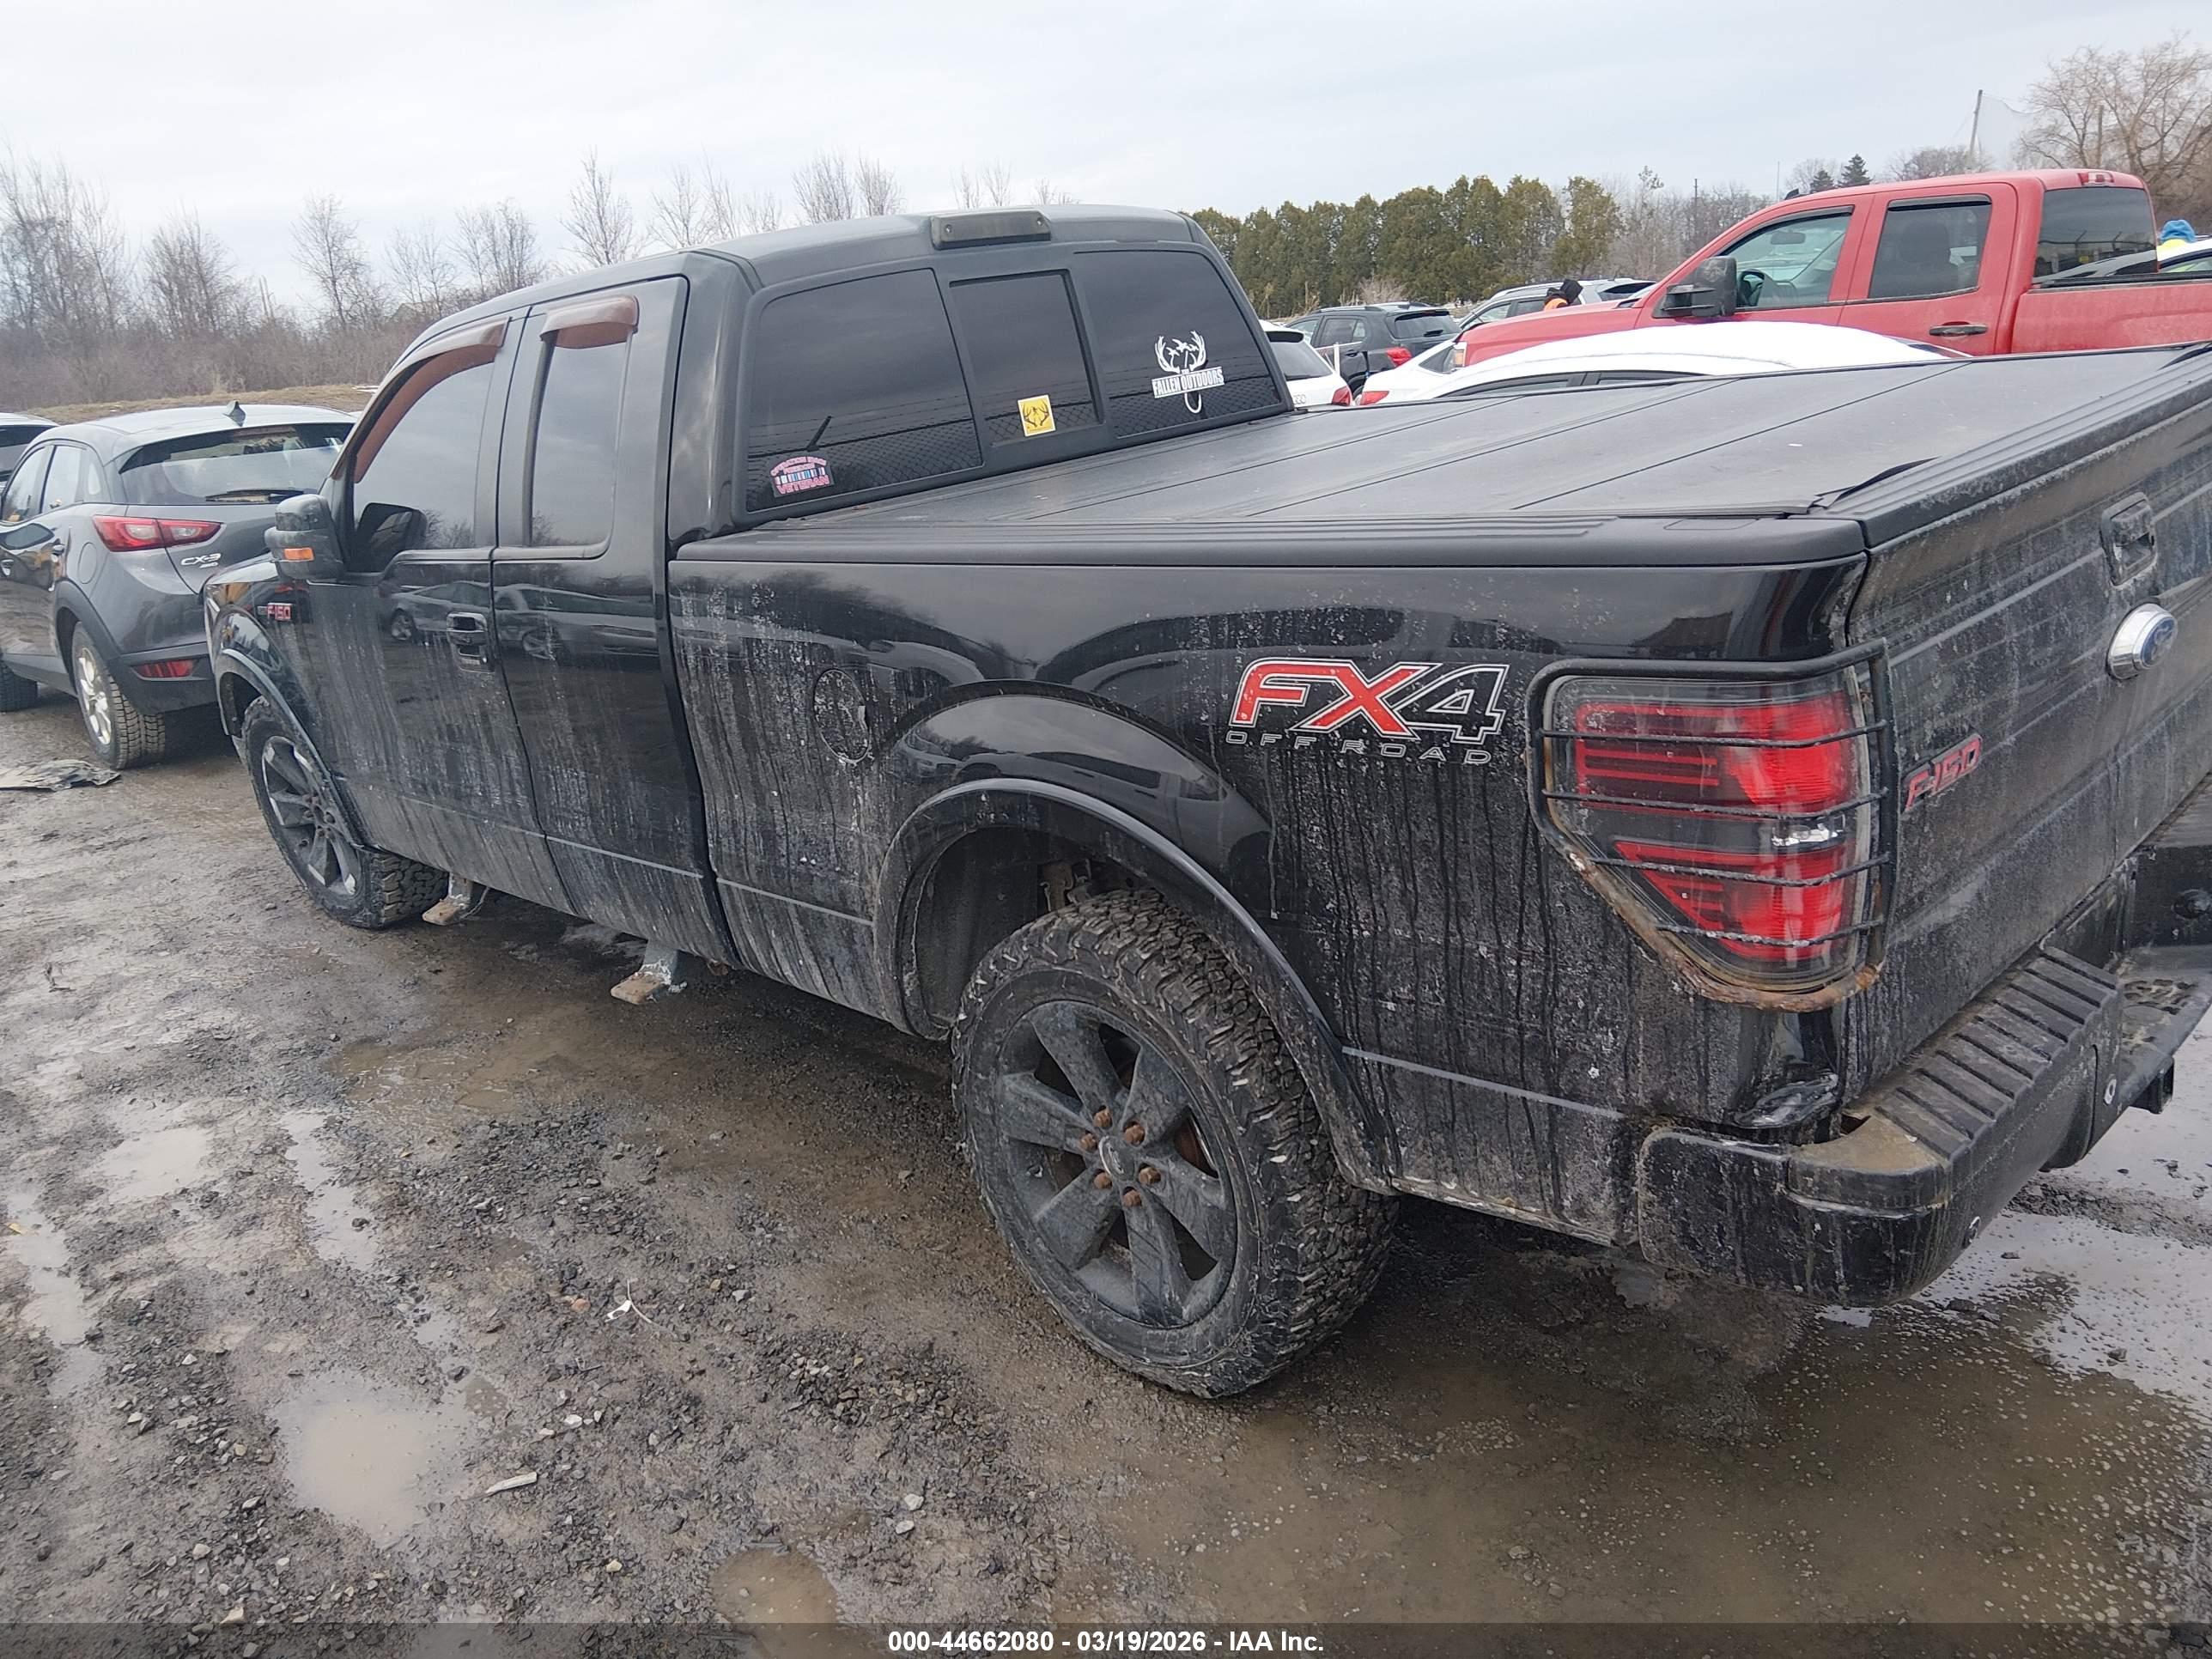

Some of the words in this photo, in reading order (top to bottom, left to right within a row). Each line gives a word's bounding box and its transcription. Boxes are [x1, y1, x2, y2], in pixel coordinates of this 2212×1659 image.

[1152, 376, 1182, 396] FALLEN
[1180, 368, 1224, 391] OUTDOORS
[775, 474, 830, 495] VETERAN
[180, 552, 222, 566] CX-3
[1228, 656, 1510, 745] FX4
[1225, 729, 1317, 750] OFF
[1340, 740, 1492, 765] ROAD
